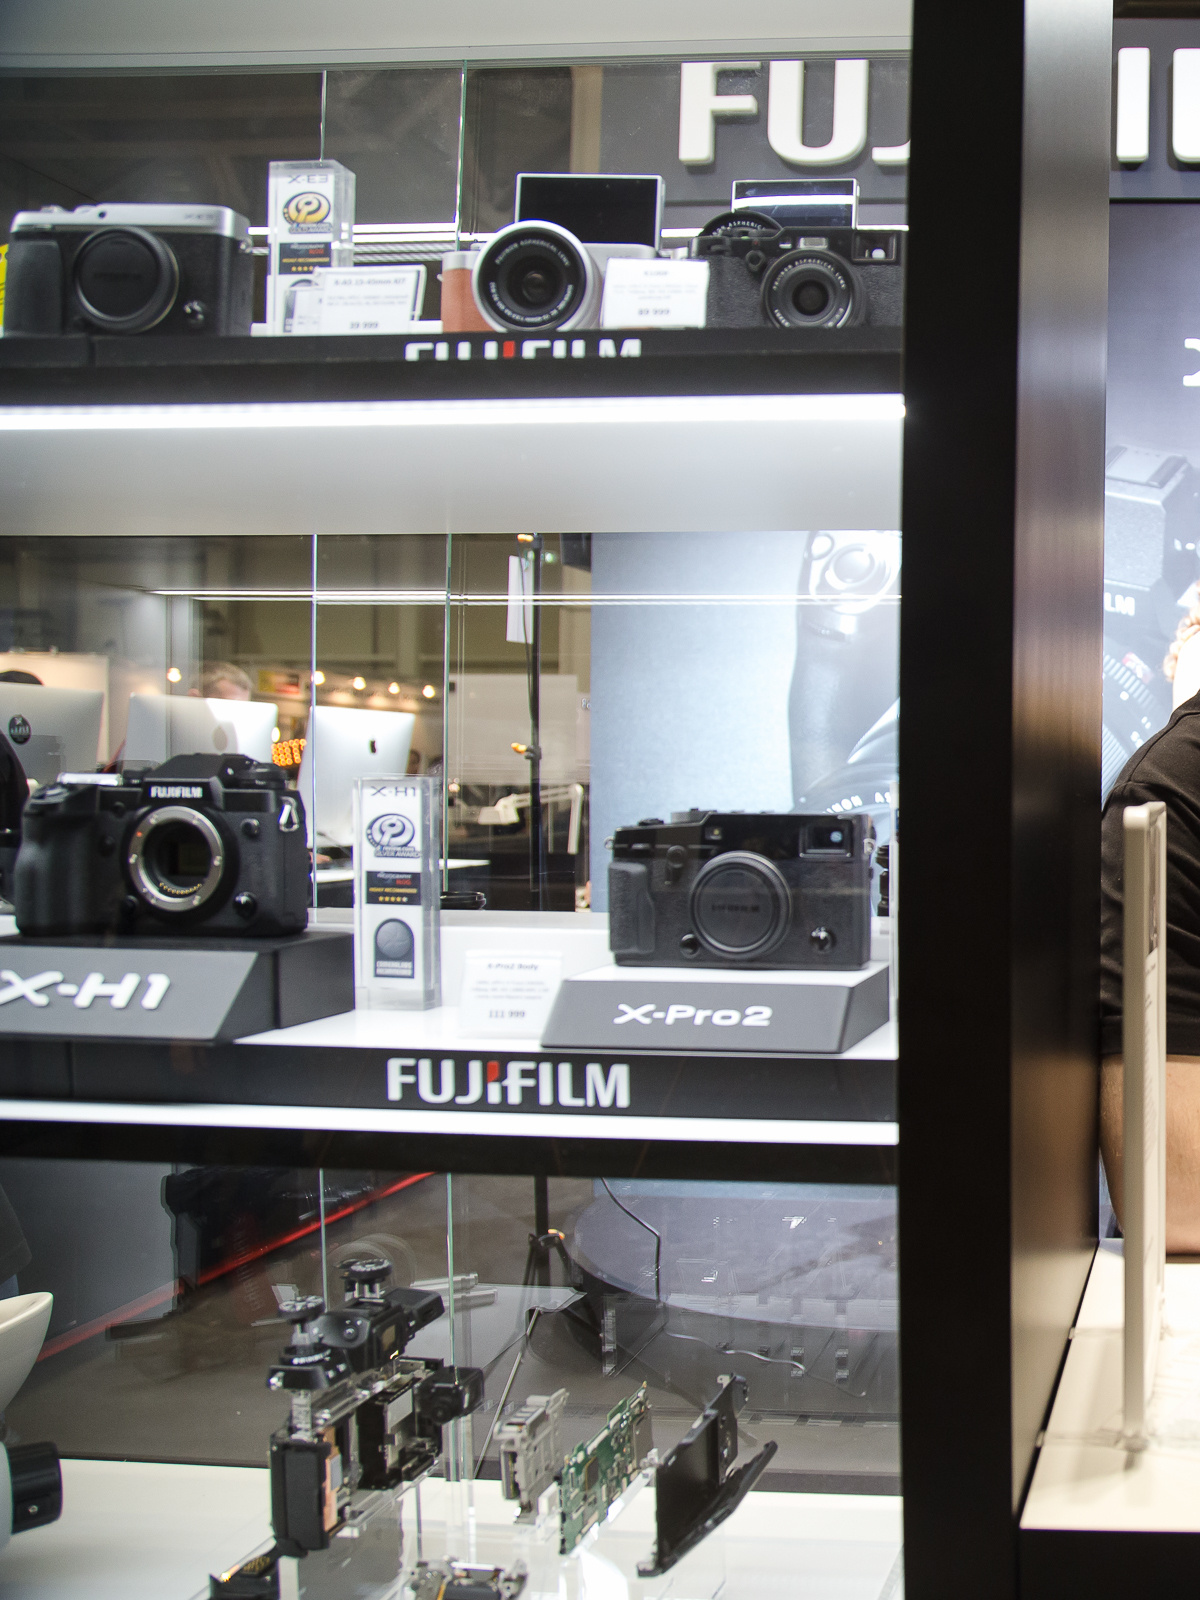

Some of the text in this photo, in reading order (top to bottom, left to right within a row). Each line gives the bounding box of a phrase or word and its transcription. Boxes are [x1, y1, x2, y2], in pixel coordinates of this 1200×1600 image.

[288, 174, 328, 184] X-E3
[150, 786, 203, 799] FUJIFILM
[371, 785, 416, 797] X-H1
[517, 963, 539, 971] Body
[0, 968, 171, 1010] X-H1
[488, 1009, 526, 1018] 111 999
[612, 1003, 774, 1027] X-Pro2
[386, 1057, 631, 1109] FUJIFILM
